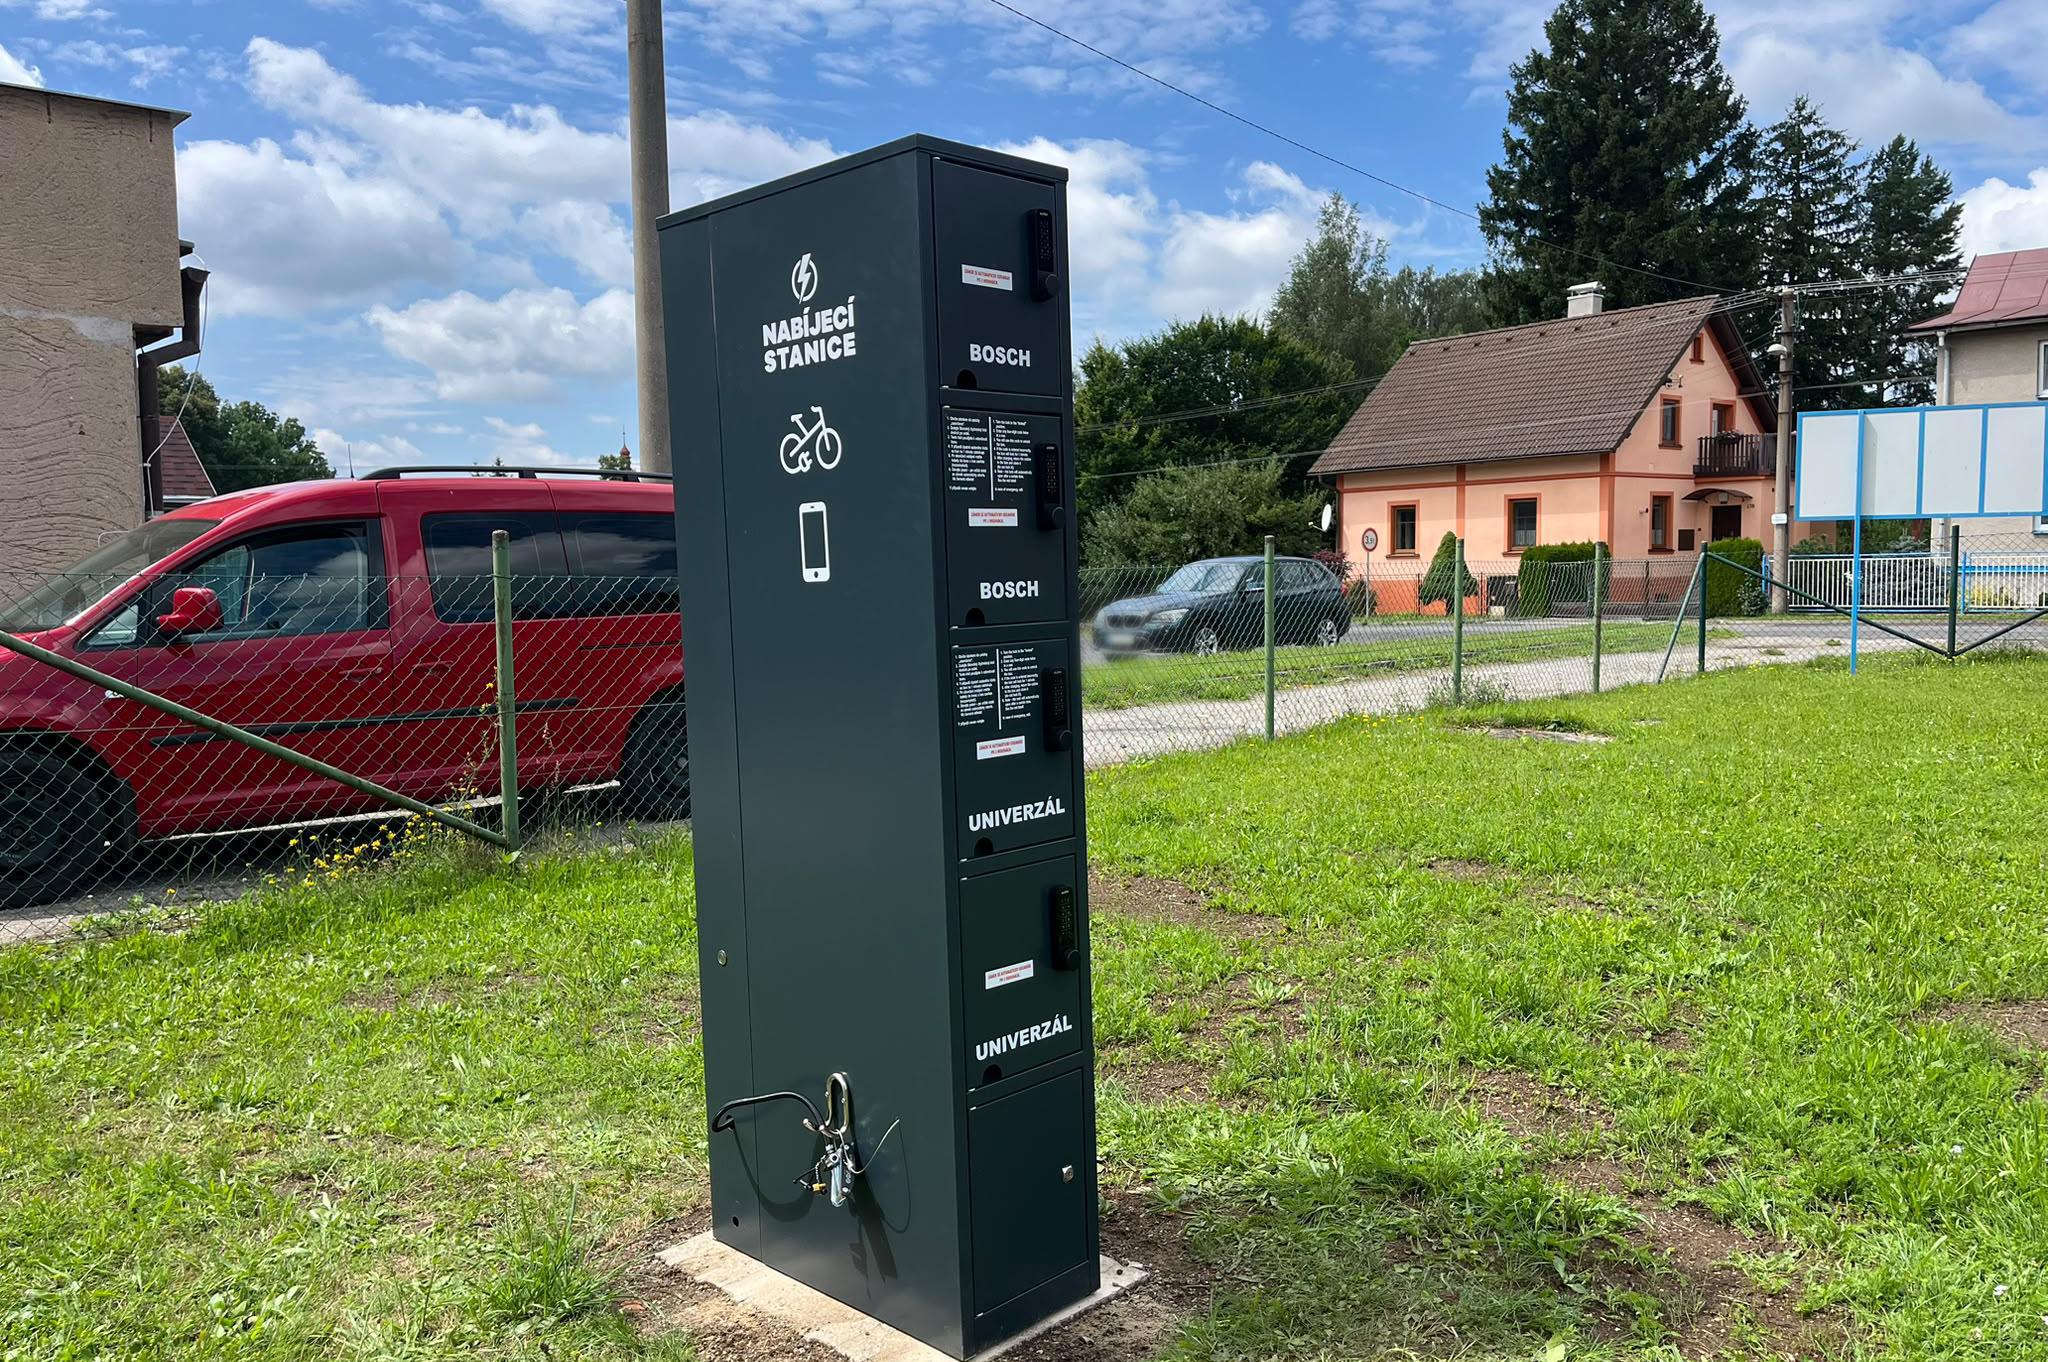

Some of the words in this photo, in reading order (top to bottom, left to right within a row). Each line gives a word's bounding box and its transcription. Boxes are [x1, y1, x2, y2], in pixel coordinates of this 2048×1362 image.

[762, 295, 855, 346] NABÍJECÍ
[764, 331, 856, 374] STANICE
[969, 343, 1031, 367] BOSCH
[979, 580, 1039, 600] BOSCH
[968, 795, 1066, 832] UNIVERZÁL
[975, 1014, 1073, 1061] UNIVERZÁL
